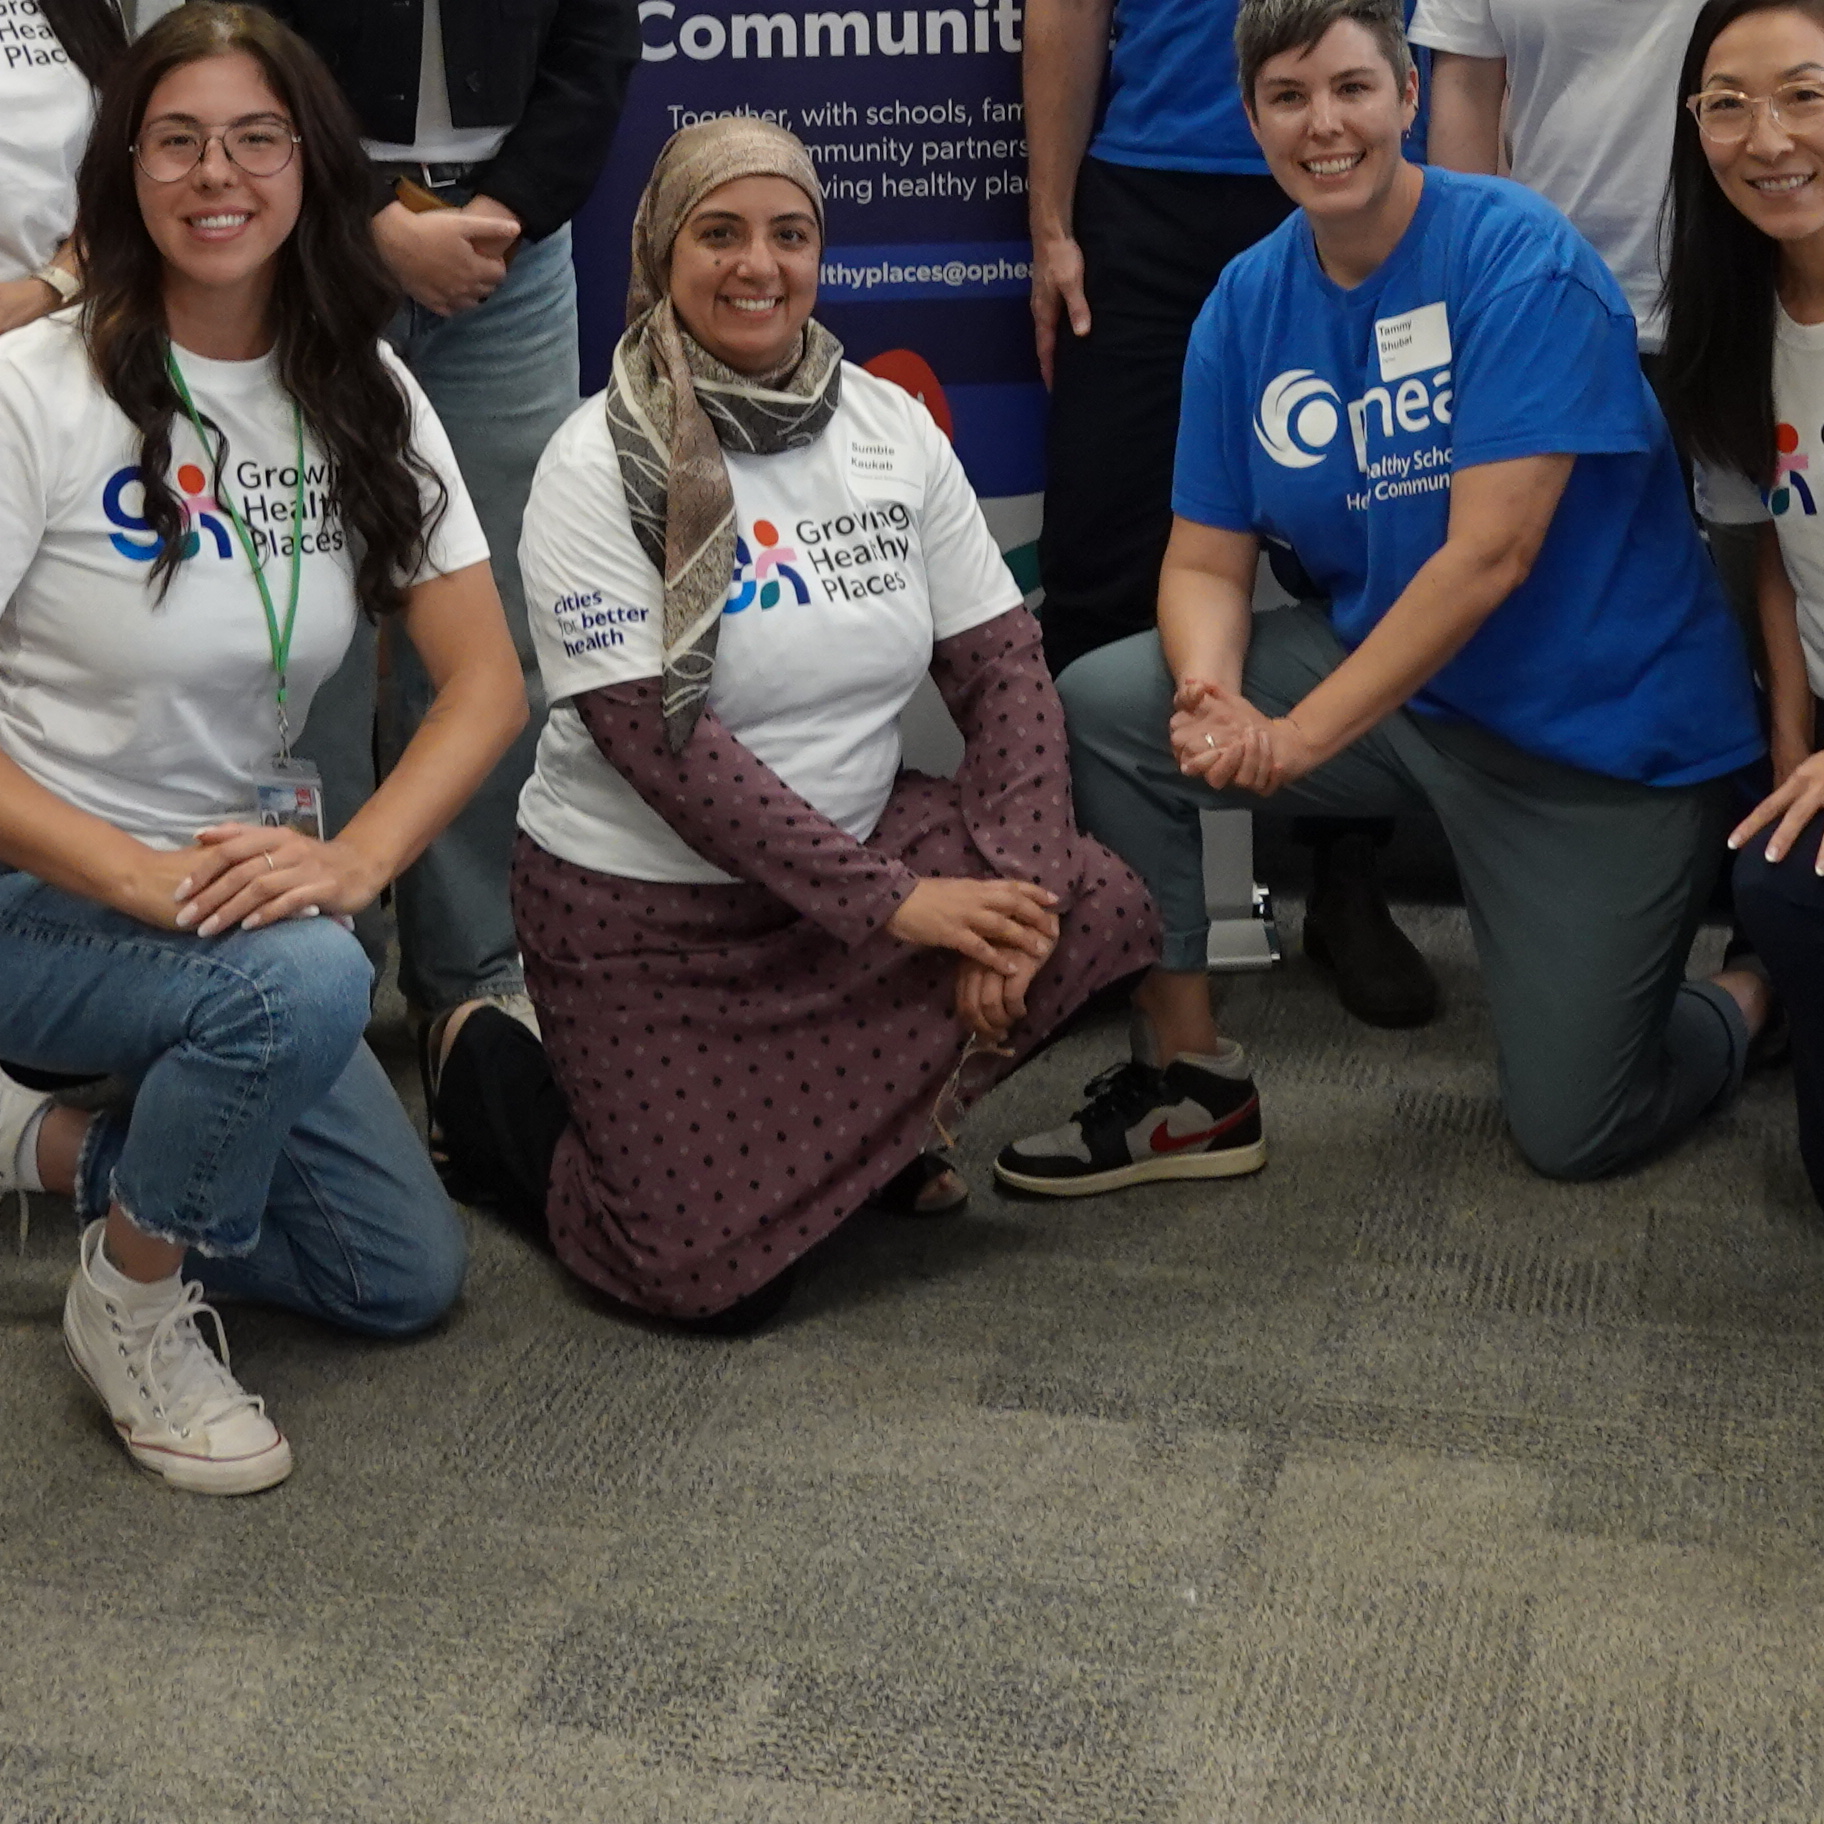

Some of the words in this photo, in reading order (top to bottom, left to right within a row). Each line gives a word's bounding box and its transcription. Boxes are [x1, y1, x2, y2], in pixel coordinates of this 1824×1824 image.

[801, 101, 858, 127] with
[865, 99, 974, 128] schools,
[805, 136, 914, 167] mmunity
[882, 170, 977, 202] healthy
[1374, 472, 1451, 501] Commun
[554, 589, 603, 615] cities
[821, 571, 907, 603] Places
[581, 606, 650, 630] better
[563, 627, 625, 658] health
